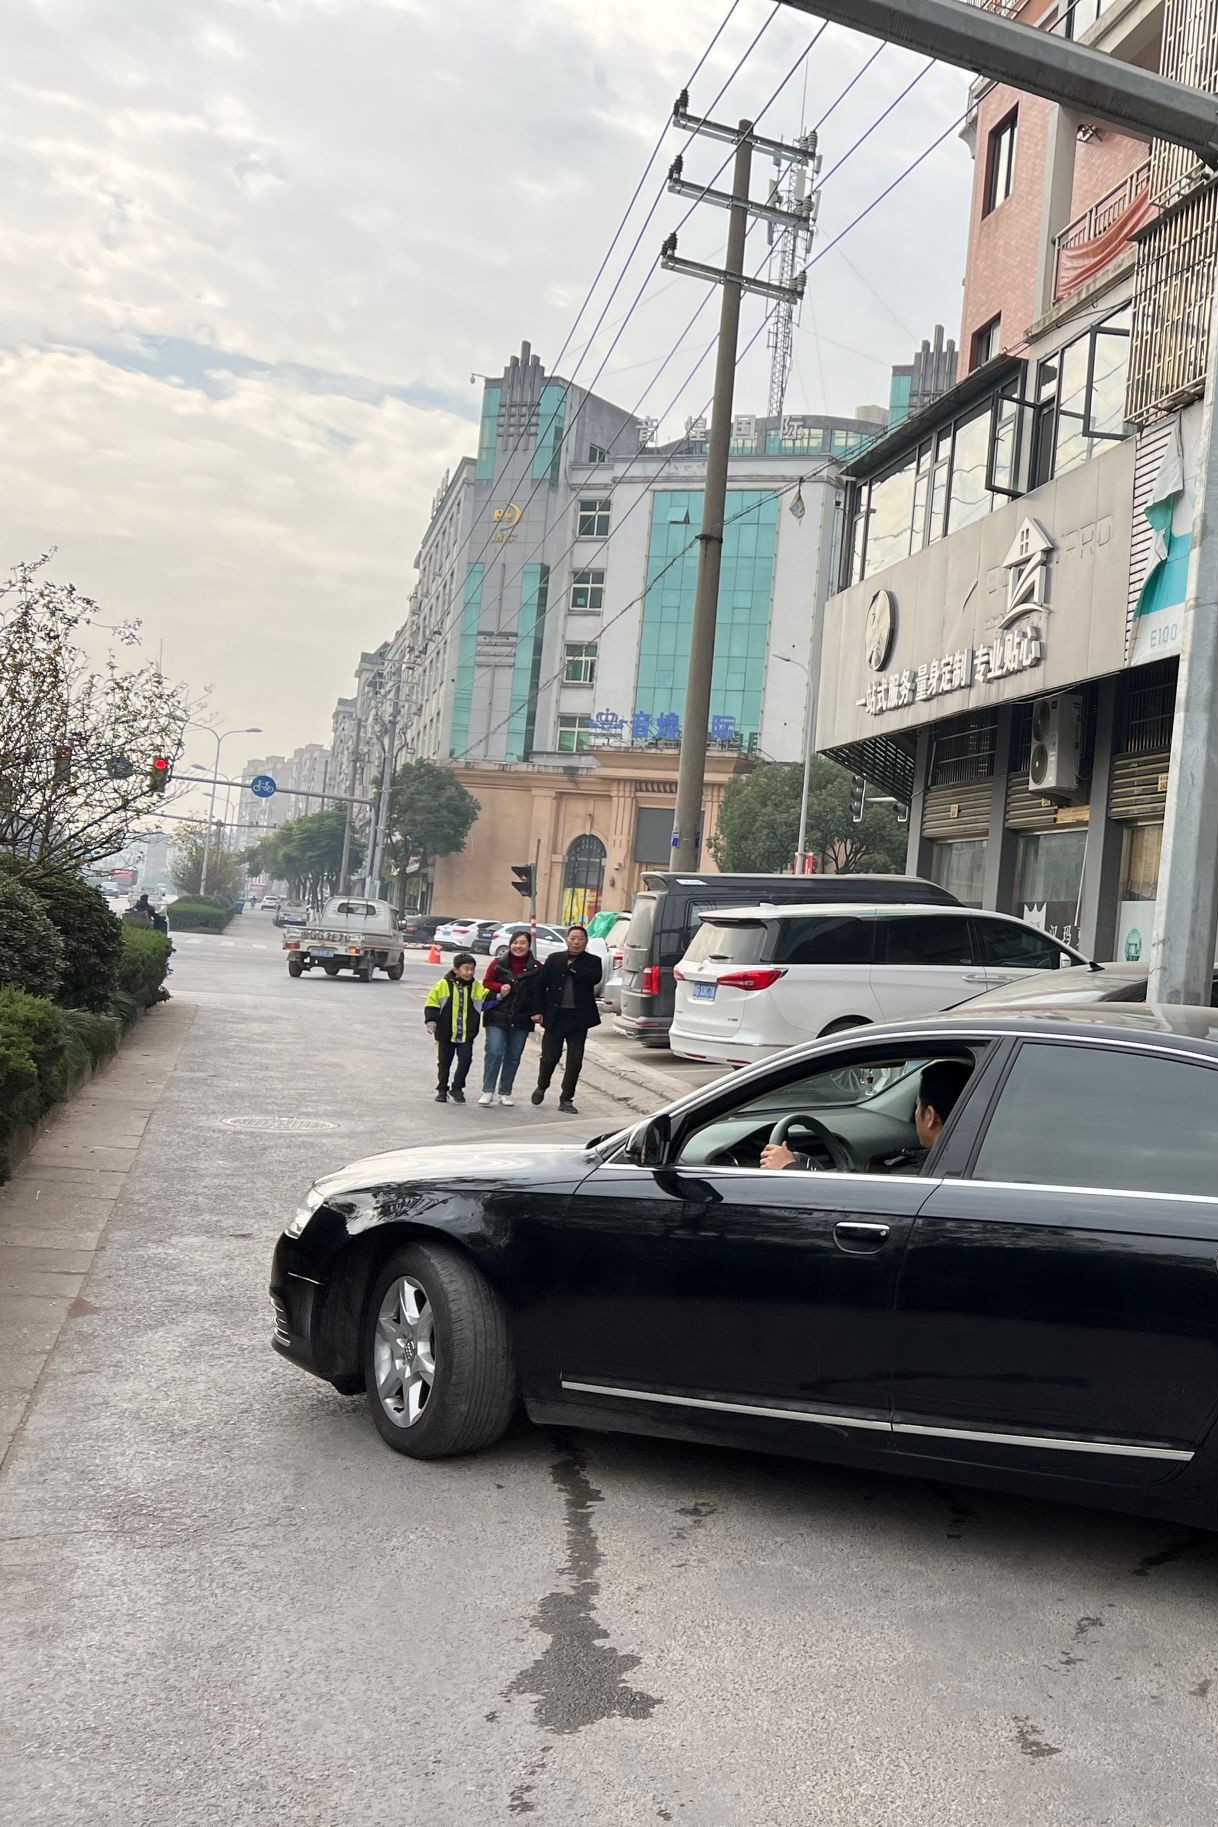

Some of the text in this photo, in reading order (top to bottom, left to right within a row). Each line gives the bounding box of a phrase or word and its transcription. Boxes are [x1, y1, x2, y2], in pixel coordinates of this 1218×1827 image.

[1150, 623, 1178, 648] E100
[856, 625, 1041, 715] 一站式服务 量身定制 专业贴心
